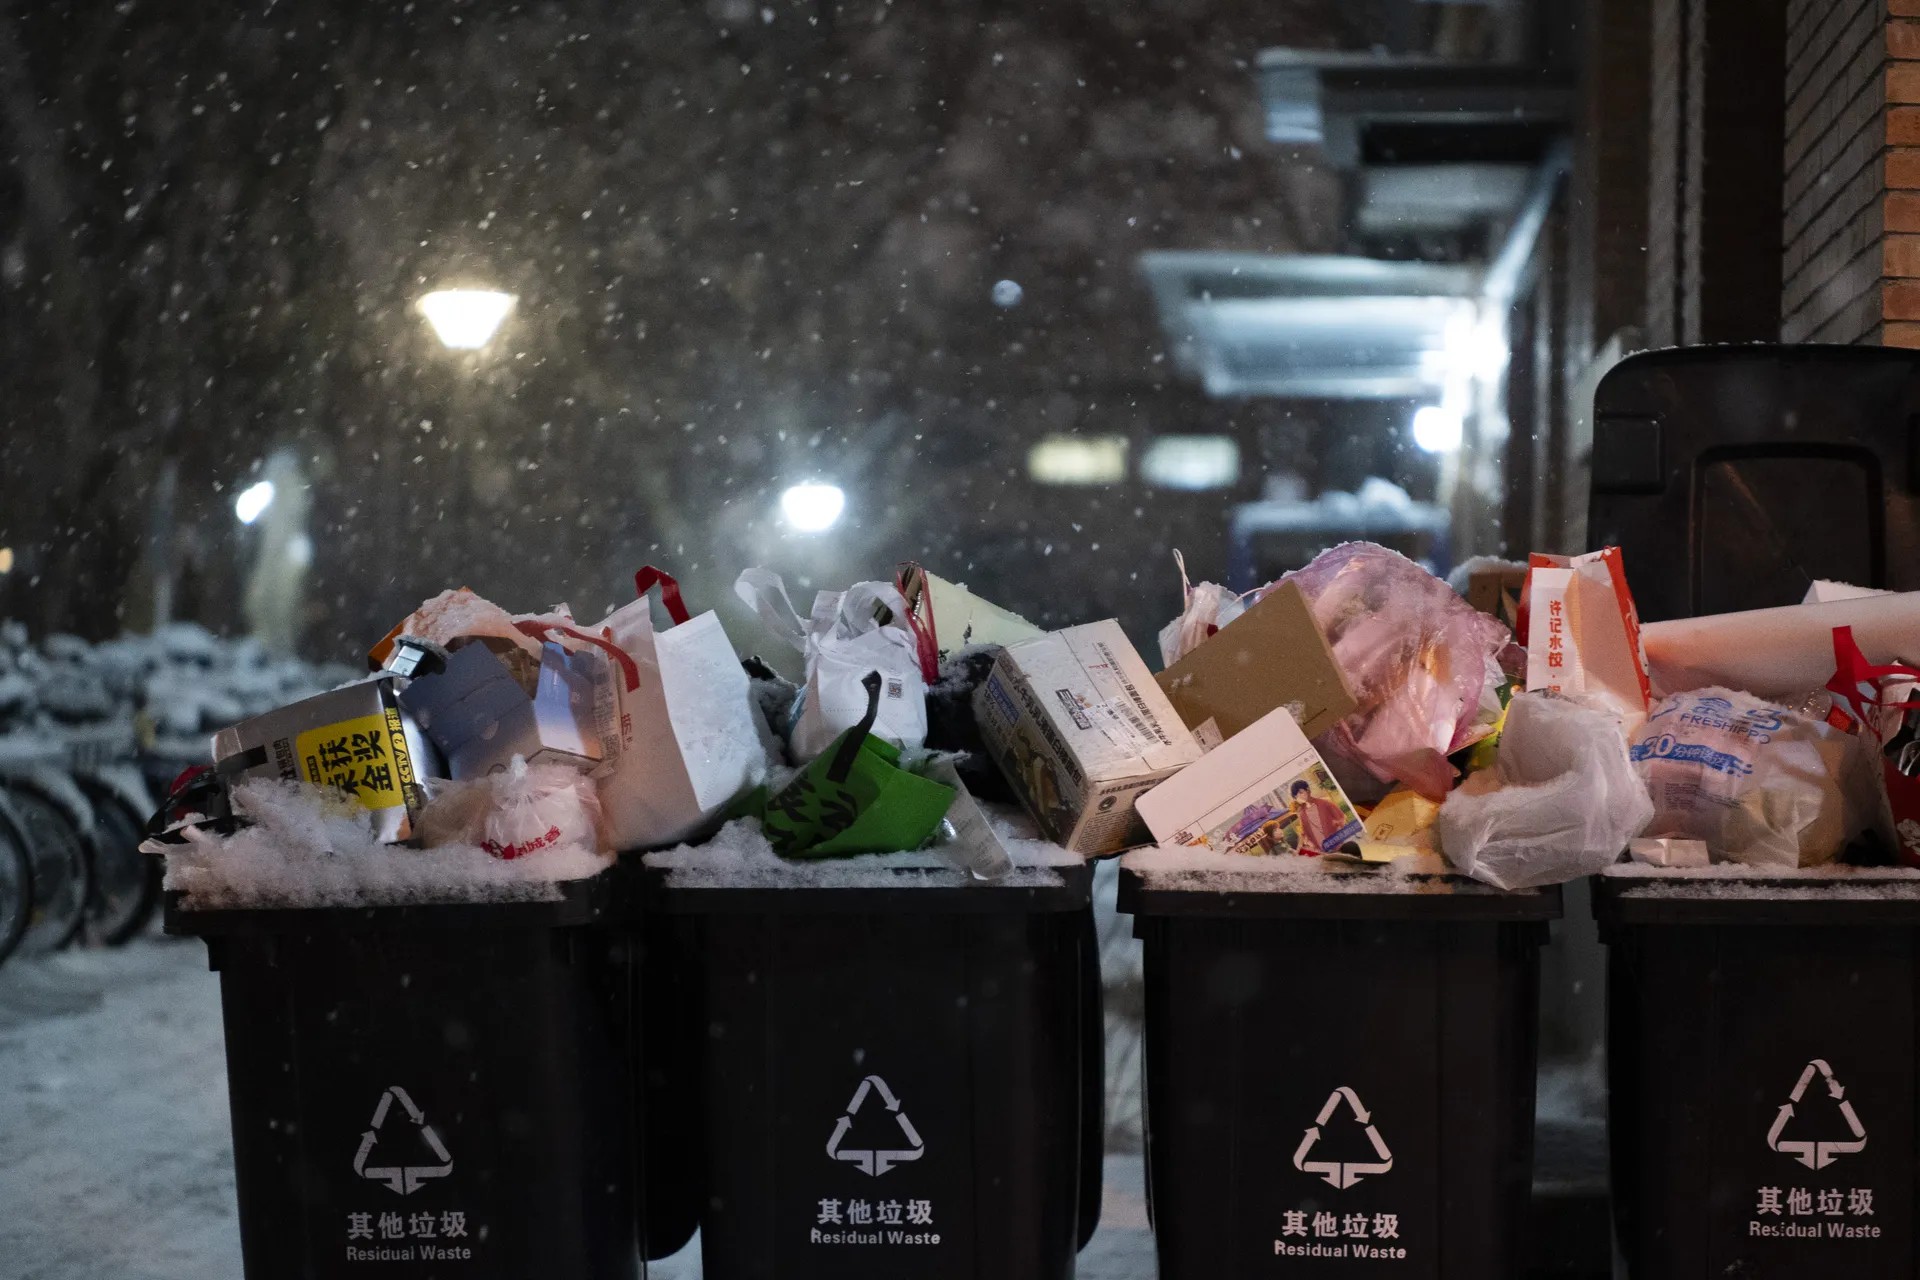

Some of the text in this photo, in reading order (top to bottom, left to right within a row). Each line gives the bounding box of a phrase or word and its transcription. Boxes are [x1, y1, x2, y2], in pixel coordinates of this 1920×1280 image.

[1679, 713, 1772, 745] FRESHIPPO
[351, 730, 394, 793] 金奖
[396, 747, 414, 783] CCTV
[817, 1199, 934, 1225] 其他垃圾
[1756, 1186, 1875, 1216] 其他垃圾
[347, 1211, 468, 1240] 其他垃圾
[810, 1227, 941, 1245] Residual Waste
[1281, 1210, 1400, 1239] 其他垃圾
[1749, 1221, 1881, 1238] Residual Waste
[346, 1245, 472, 1261] Residual Waste
[1274, 1239, 1407, 1259] Residual Waste
